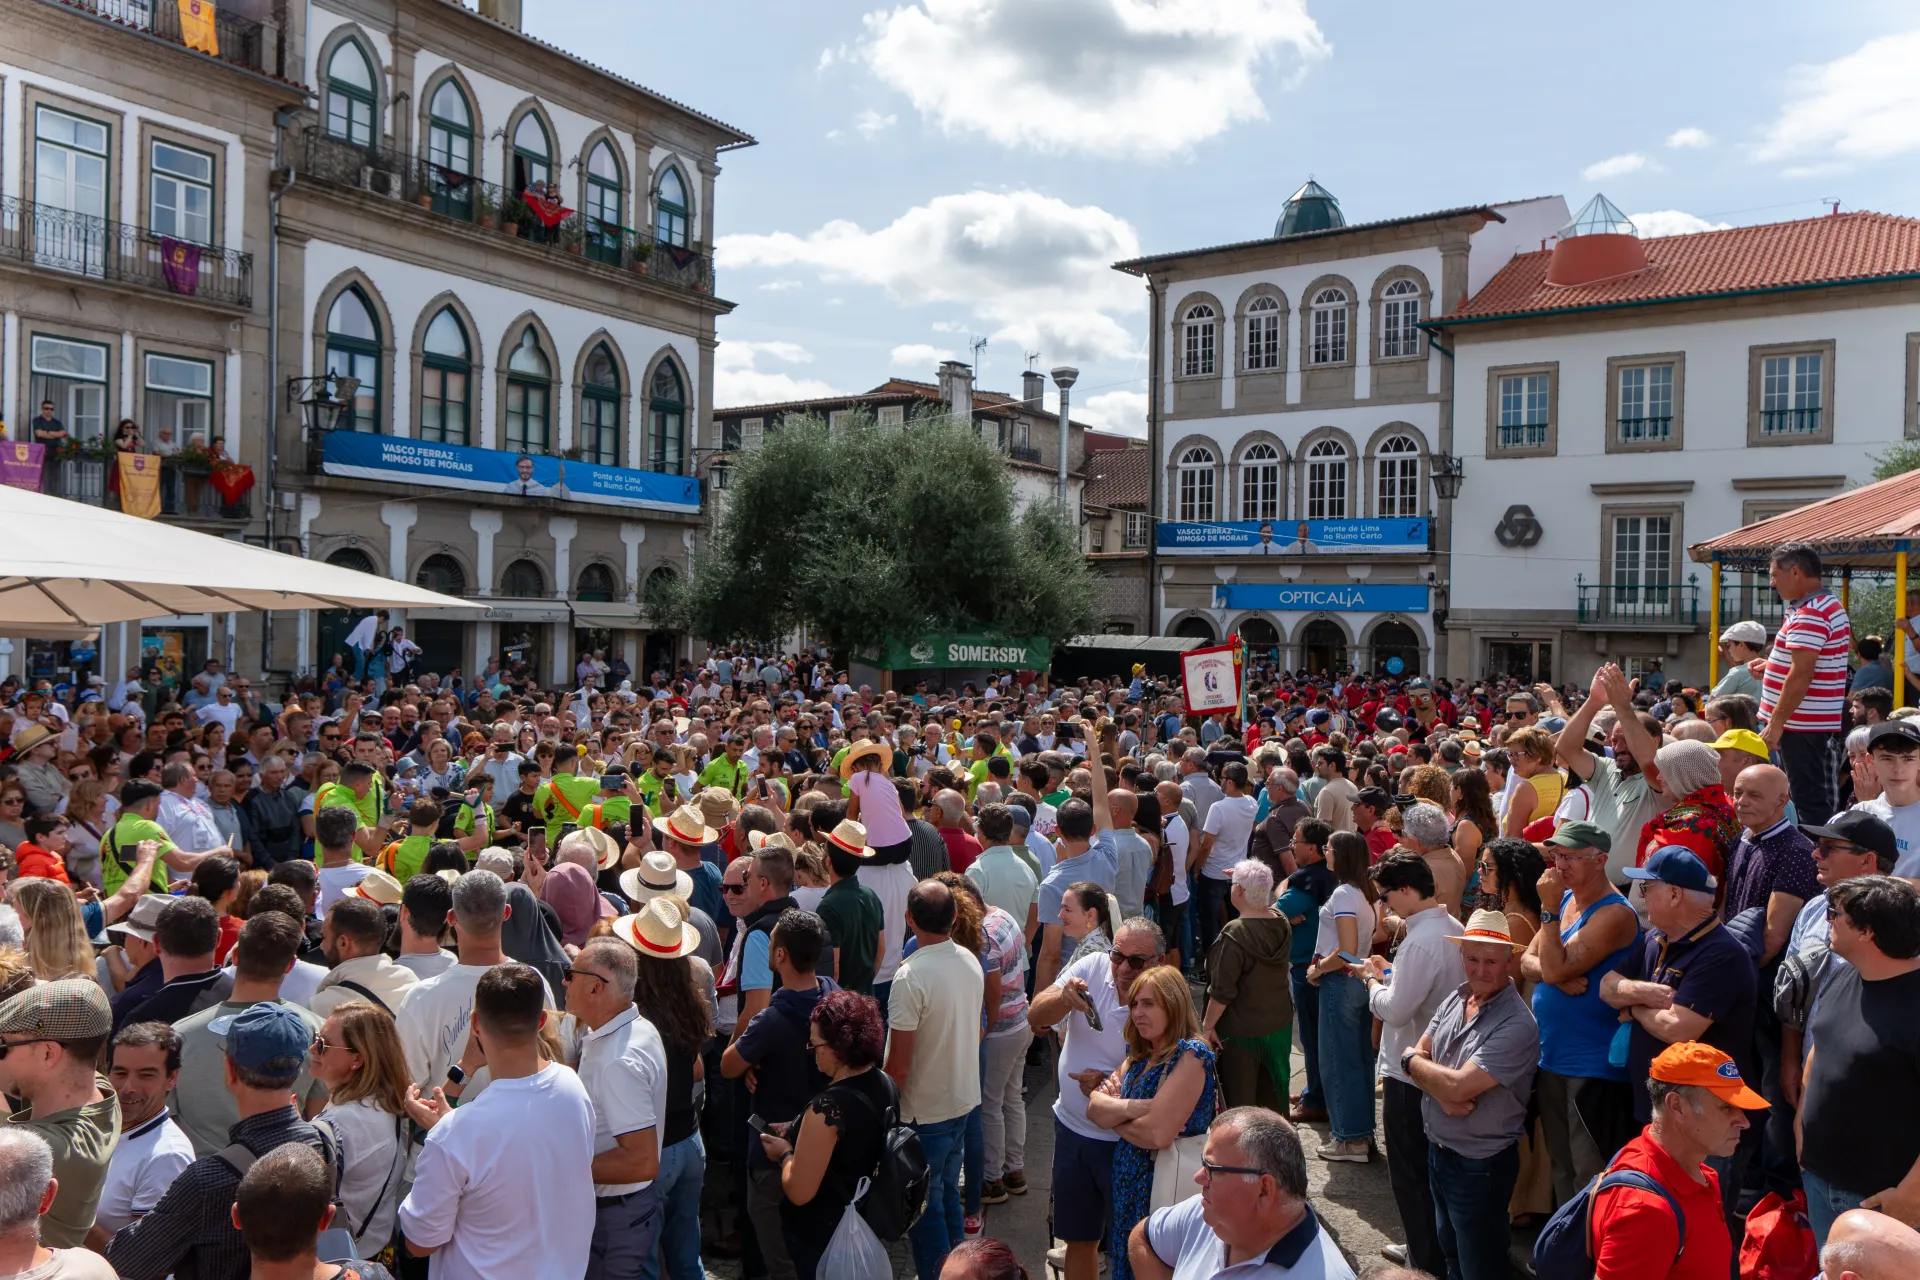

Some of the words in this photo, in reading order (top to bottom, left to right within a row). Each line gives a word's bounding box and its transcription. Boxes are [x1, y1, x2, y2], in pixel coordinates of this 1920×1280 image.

[382, 443, 415, 455] VASCO
[416, 448, 454, 460] FERRAZ
[382, 453, 421, 465] MIMOSO
[423, 458, 436, 467] DE
[438, 460, 473, 472] MORAIS
[593, 471, 613, 480] Ponte
[624, 476, 641, 484] Lima
[603, 481, 623, 490] Rumo
[624, 484, 643, 493] Certo
[1202, 527, 1232, 535] FERRAZ
[1360, 524, 1380, 532] Lima
[1176, 534, 1206, 542] MIMOSO
